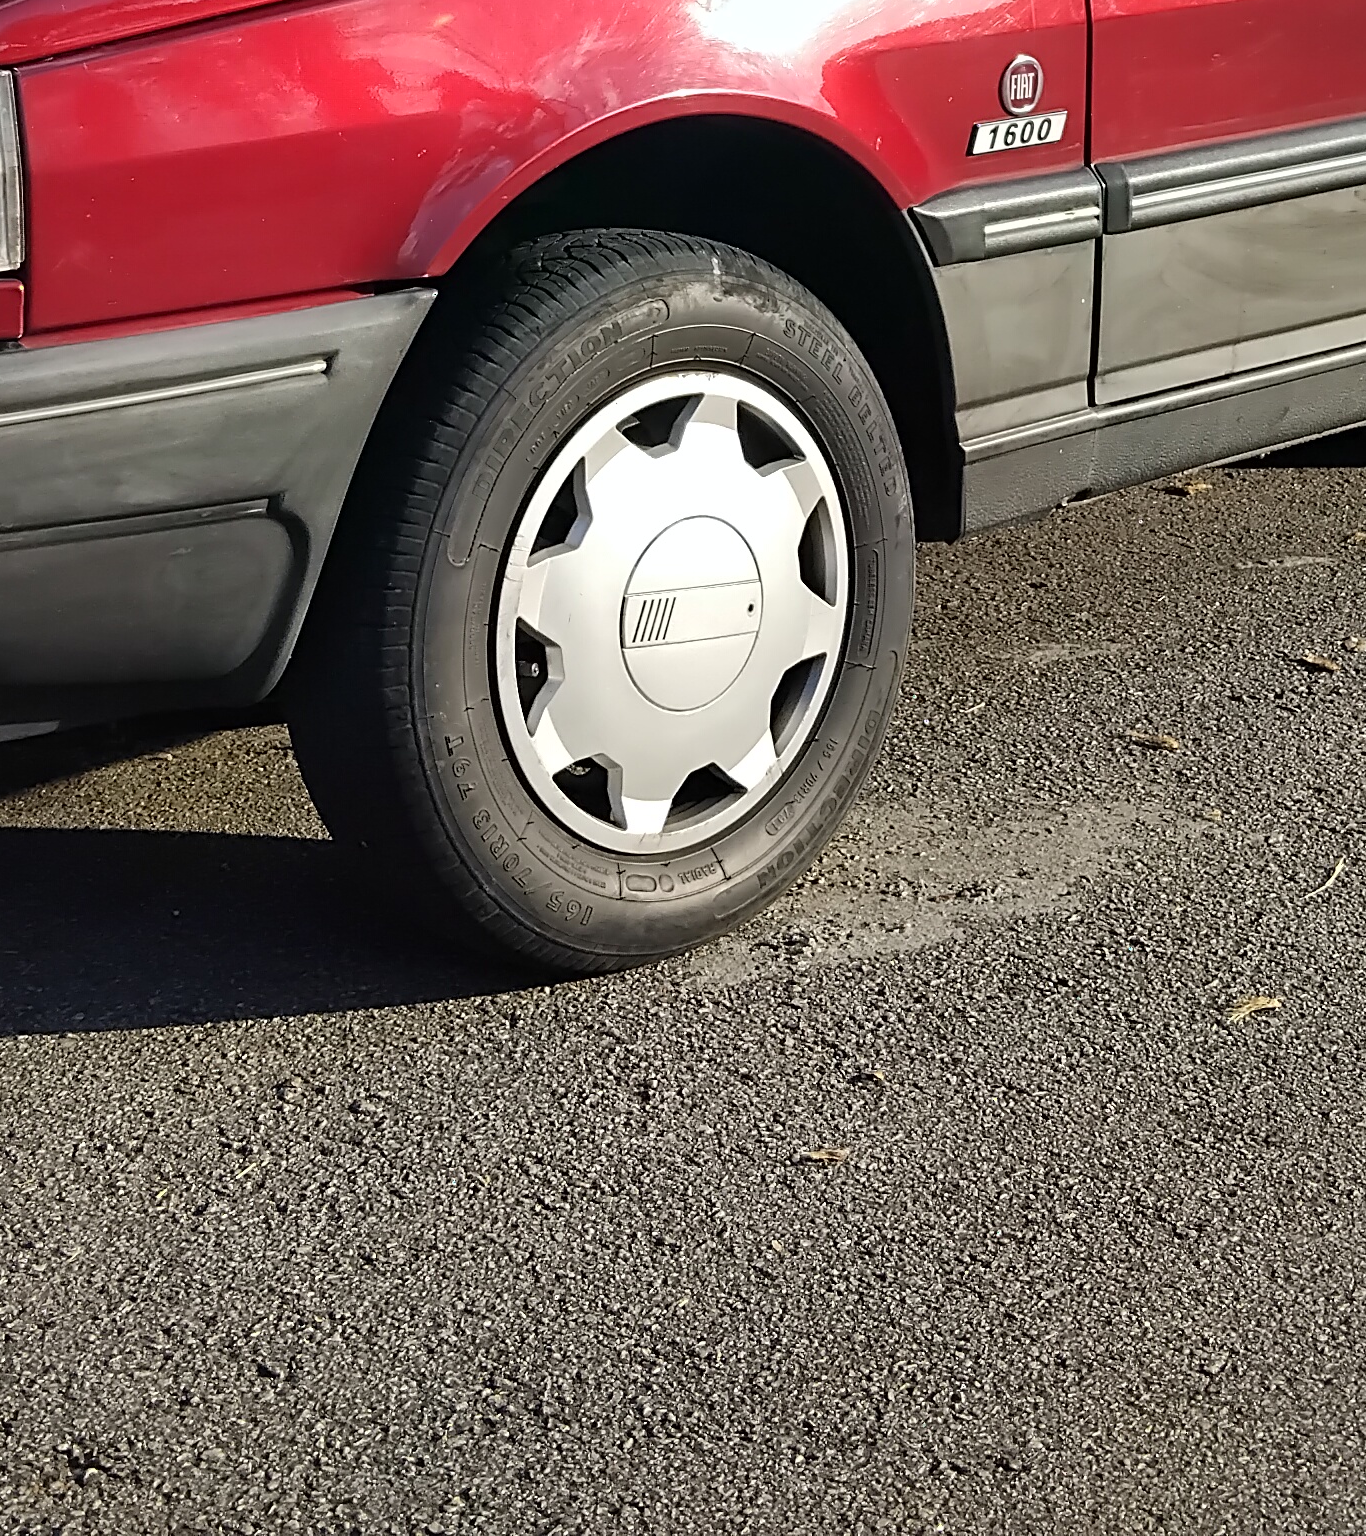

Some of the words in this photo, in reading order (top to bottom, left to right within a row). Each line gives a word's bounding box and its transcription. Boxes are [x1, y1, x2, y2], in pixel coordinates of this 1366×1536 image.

[1010, 72, 1035, 101] FIAT
[988, 117, 1052, 150] 1600
[471, 321, 623, 502] DIRECTION
[782, 318, 843, 385] STEEL
[846, 385, 897, 497] BELTED
[443, 733, 477, 801] 79T
[755, 708, 880, 889] DIRECTION
[676, 860, 718, 885] RADIAL
